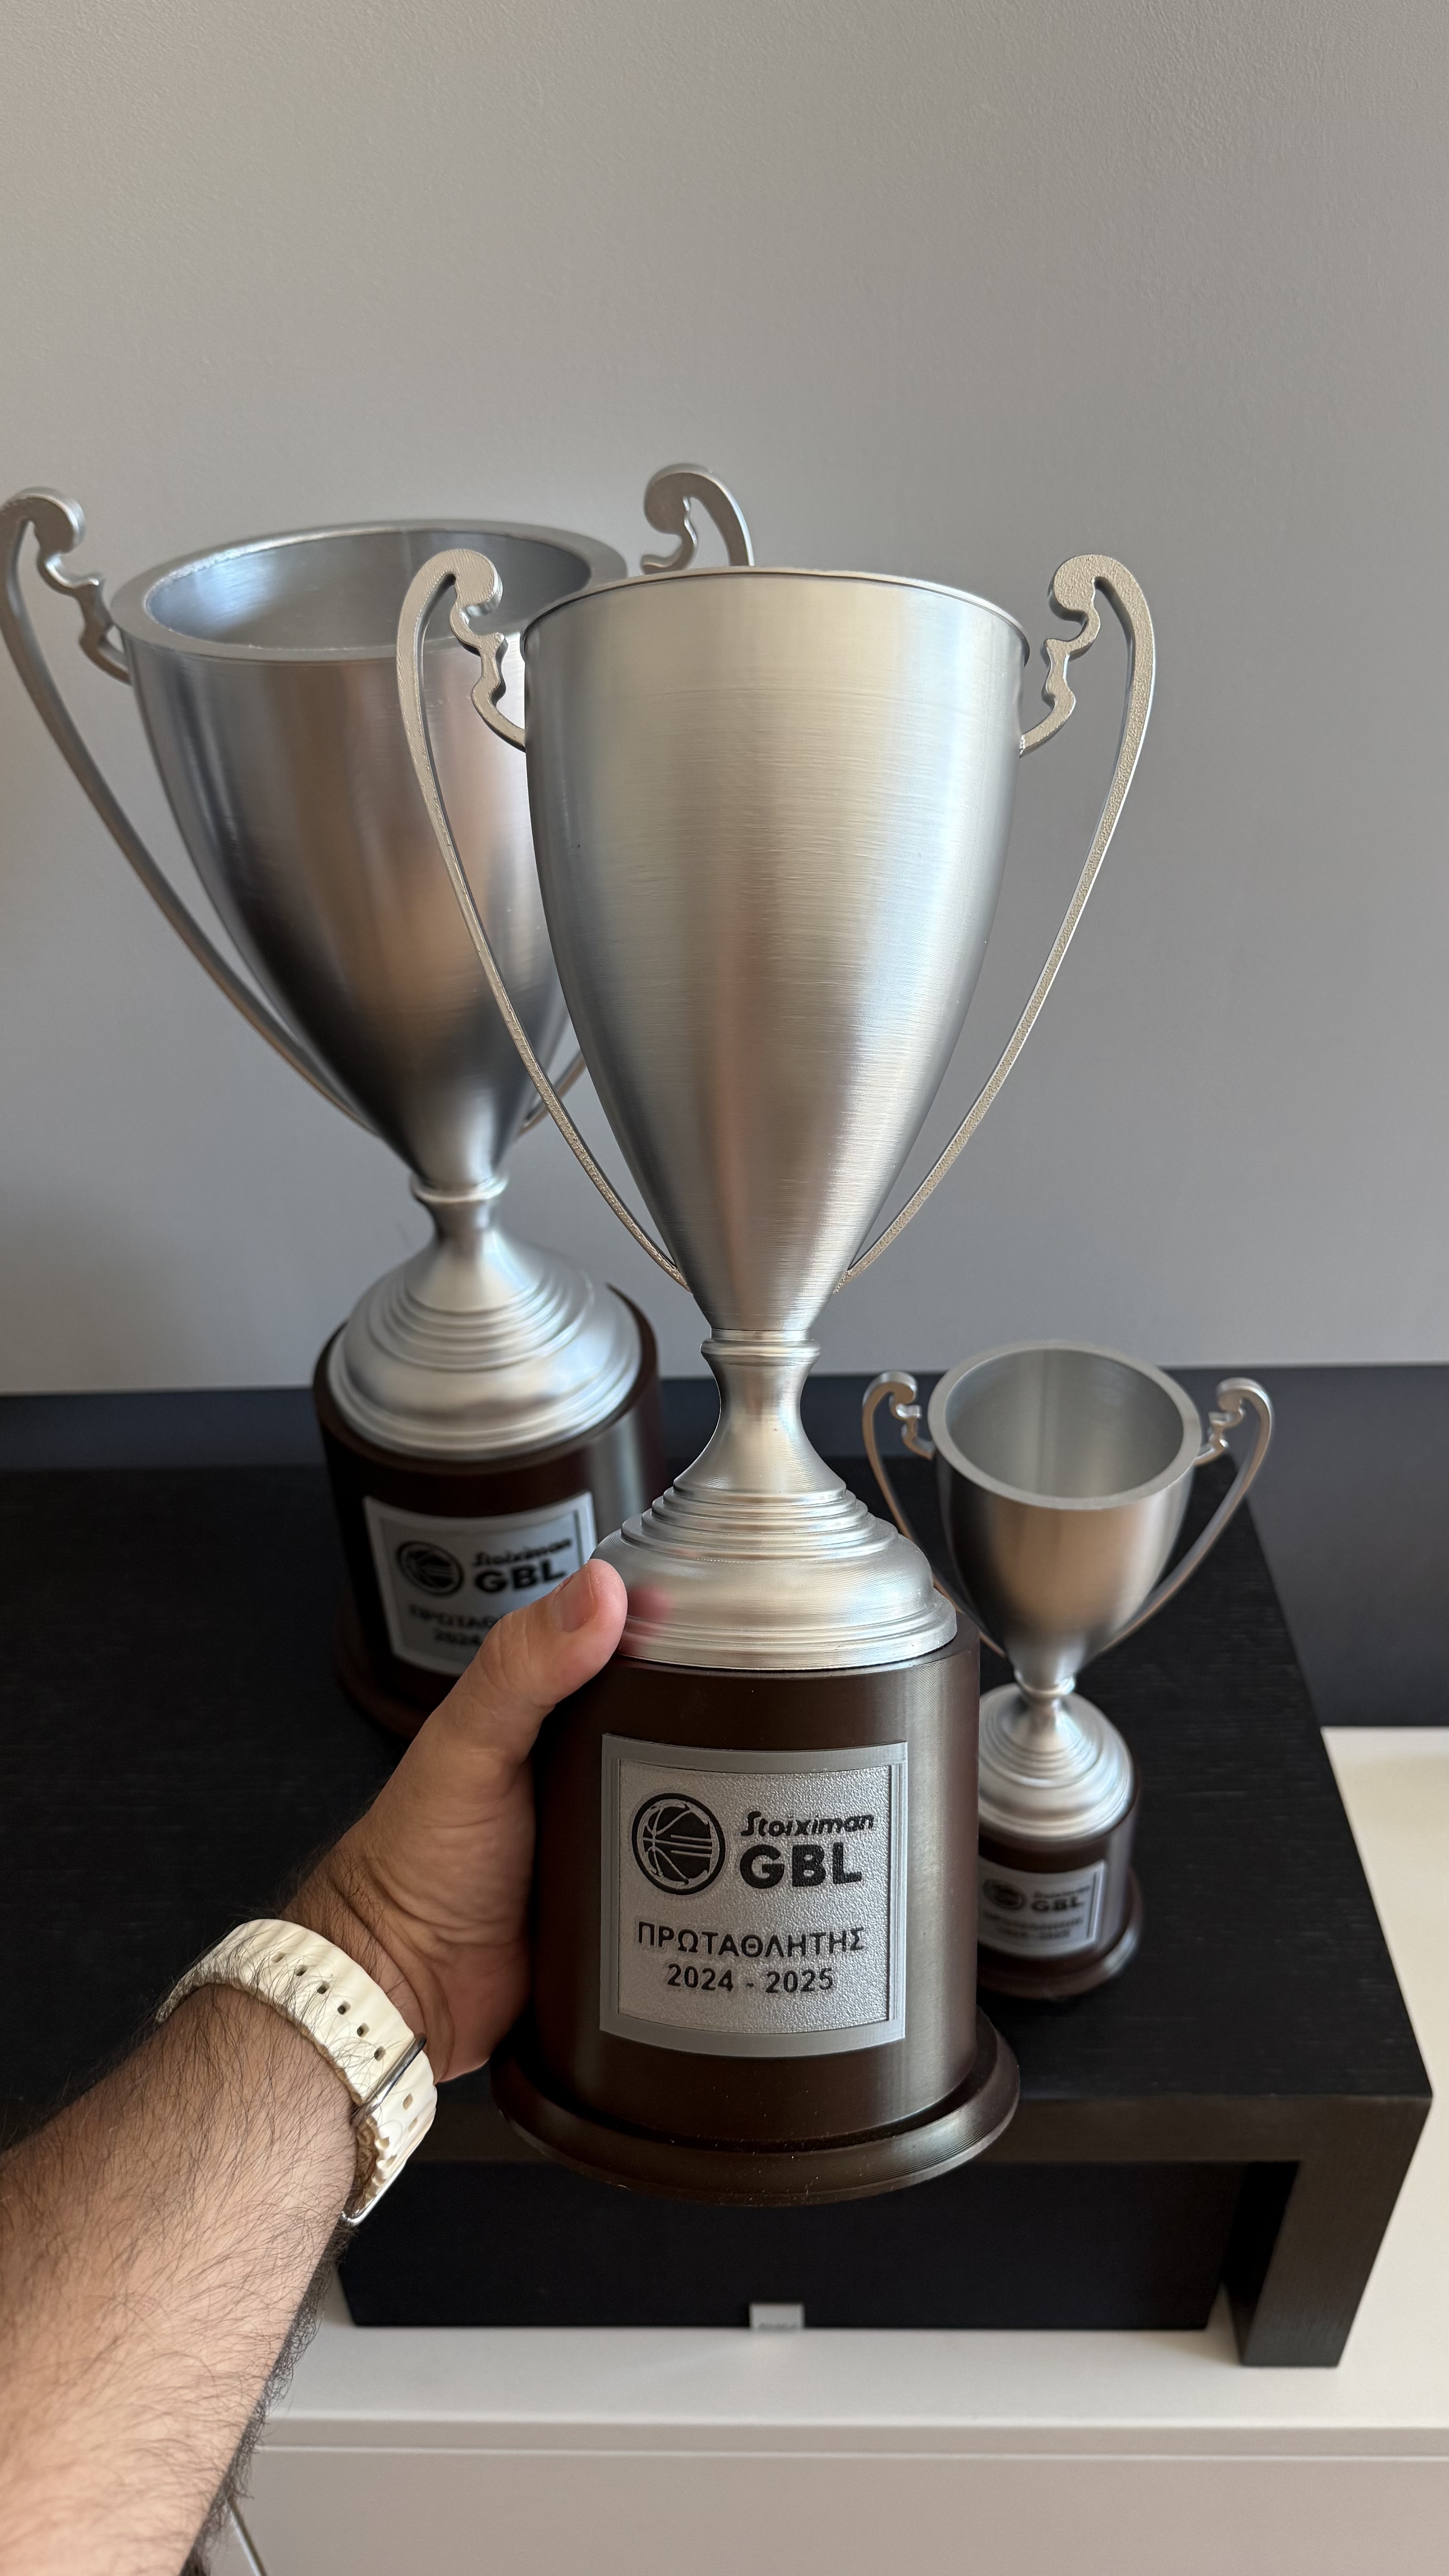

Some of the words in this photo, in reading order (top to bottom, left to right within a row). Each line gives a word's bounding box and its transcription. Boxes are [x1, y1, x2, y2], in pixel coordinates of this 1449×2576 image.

[475, 1559, 566, 1592] GBL
[741, 1811, 874, 1836] Stoiximan
[740, 1842, 862, 1889] GBL
[639, 1922, 865, 1957] ΠΡΩΤΑΘΛΗΤΗΣ
[667, 1963, 733, 1992] 2024
[766, 1968, 833, 1993] 2025
